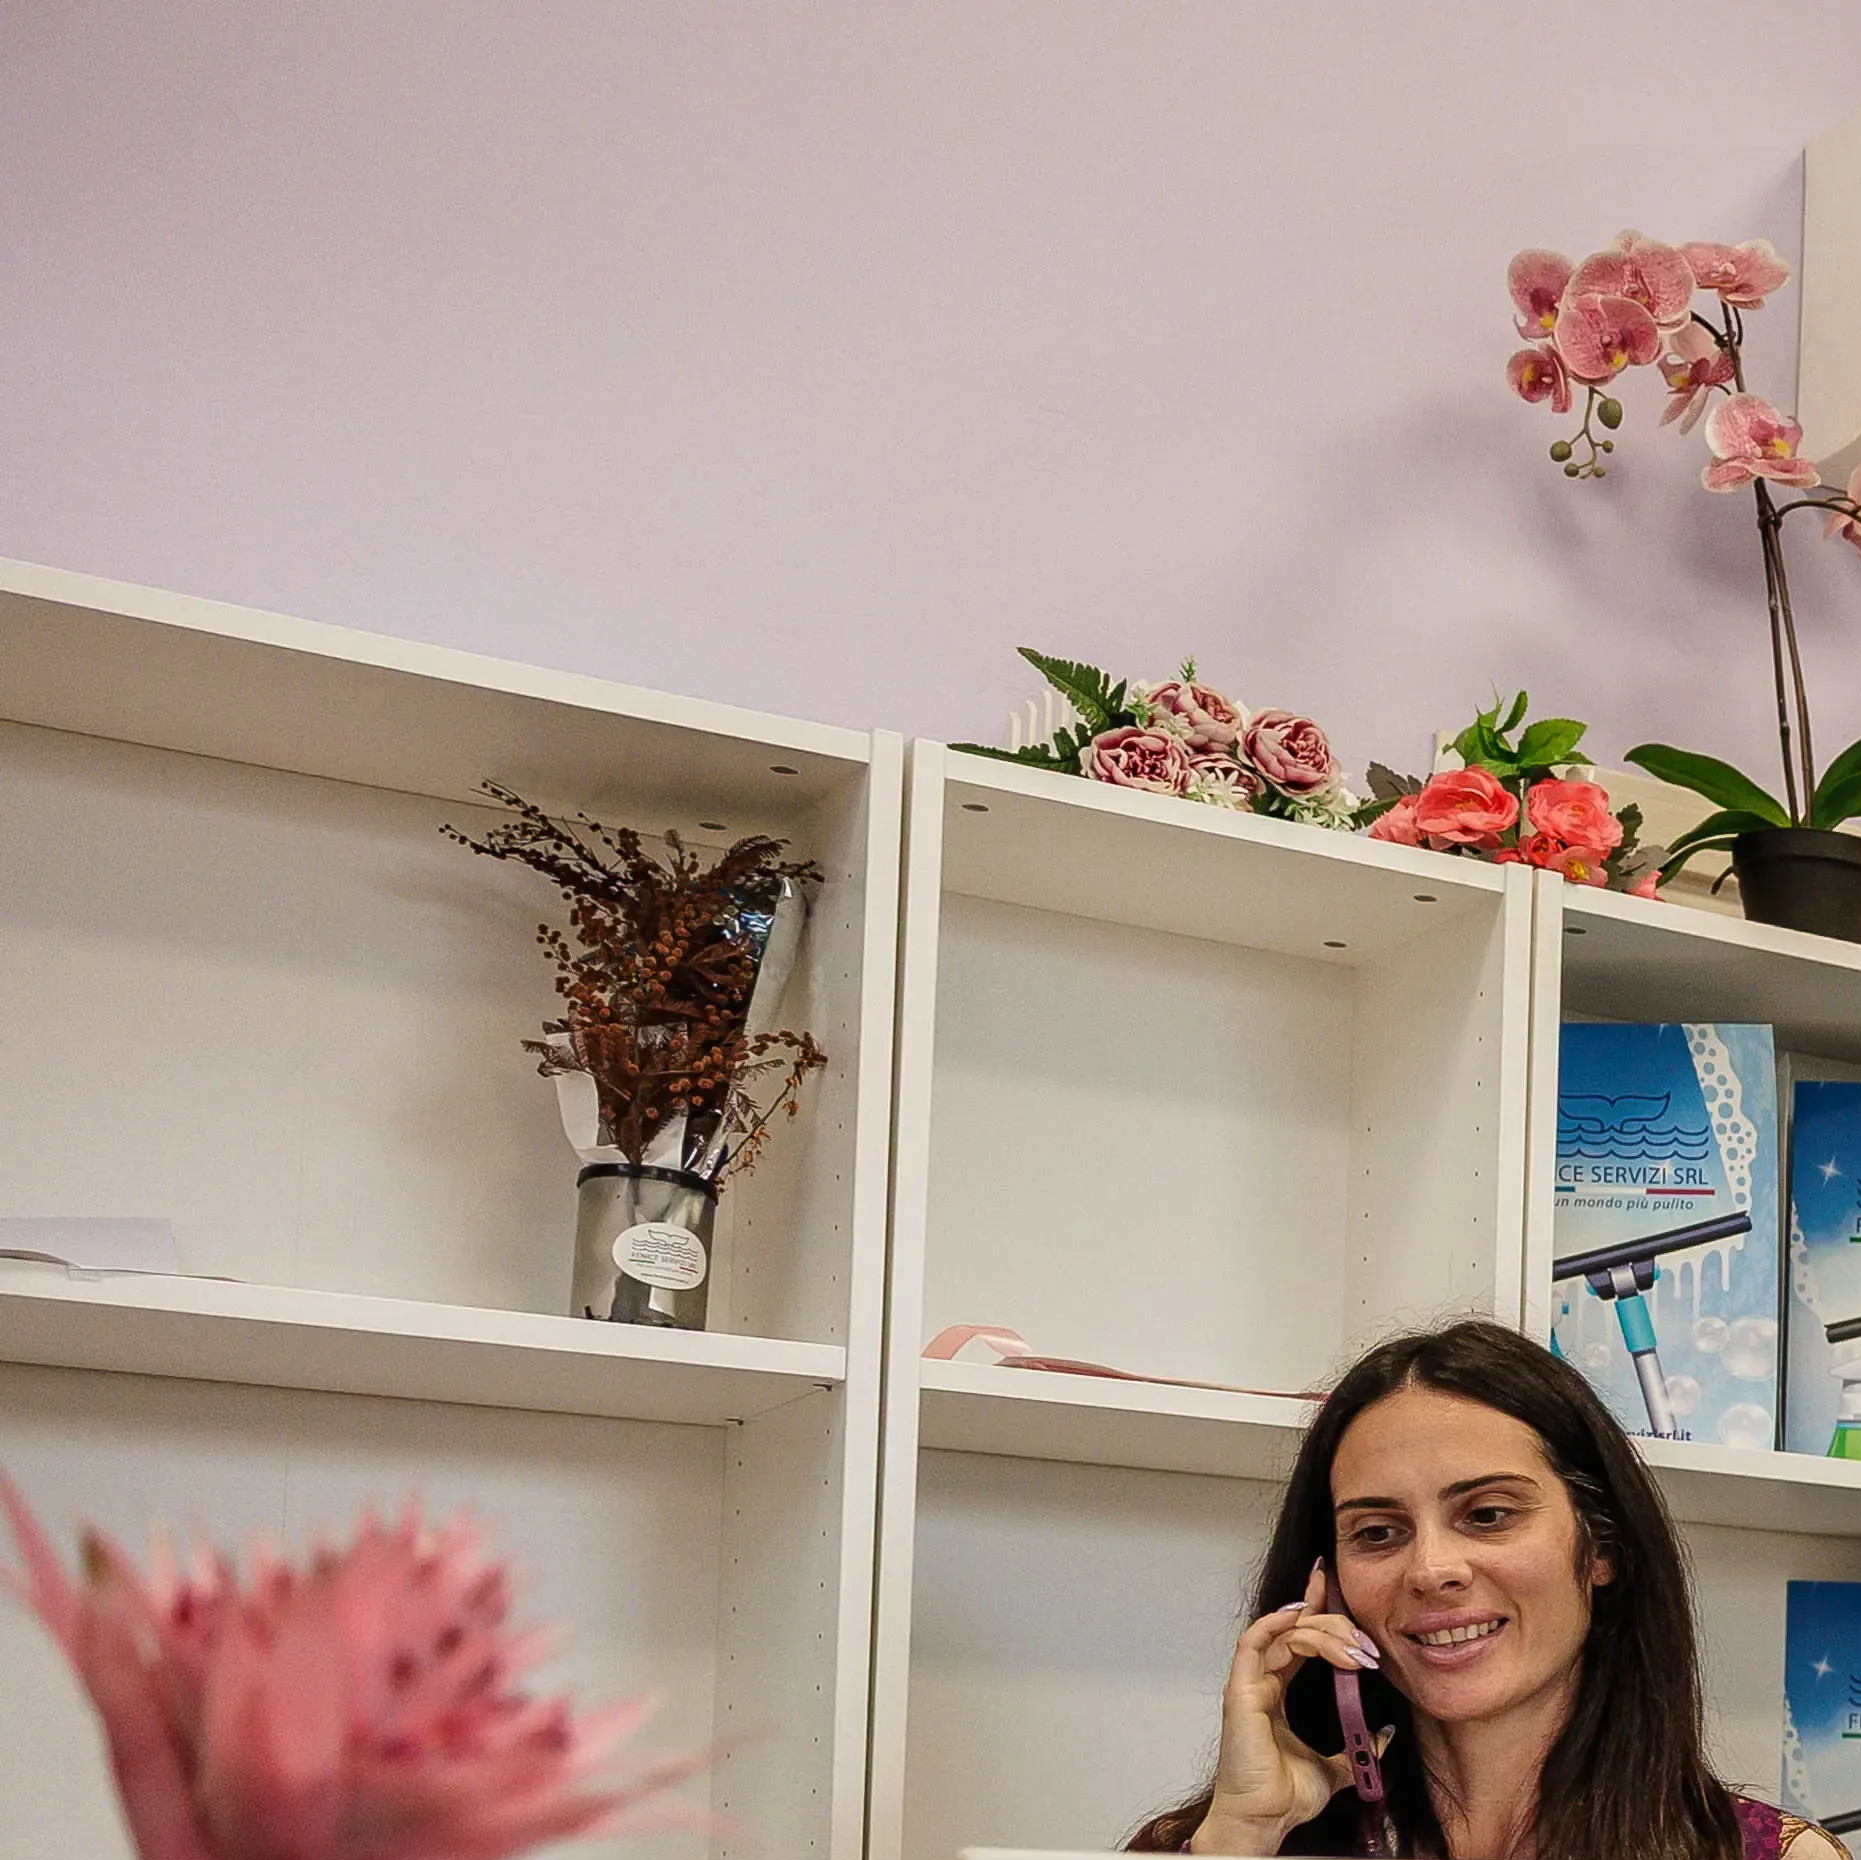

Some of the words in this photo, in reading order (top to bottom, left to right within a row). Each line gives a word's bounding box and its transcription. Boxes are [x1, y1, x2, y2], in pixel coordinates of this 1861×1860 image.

[1591, 1165, 1667, 1184] SERVIZI
[1673, 1167, 1709, 1185] SRL
[1573, 1198, 1622, 1208] mondo
[1626, 1198, 1649, 1211] più
[1652, 1198, 1694, 1211] pulito
